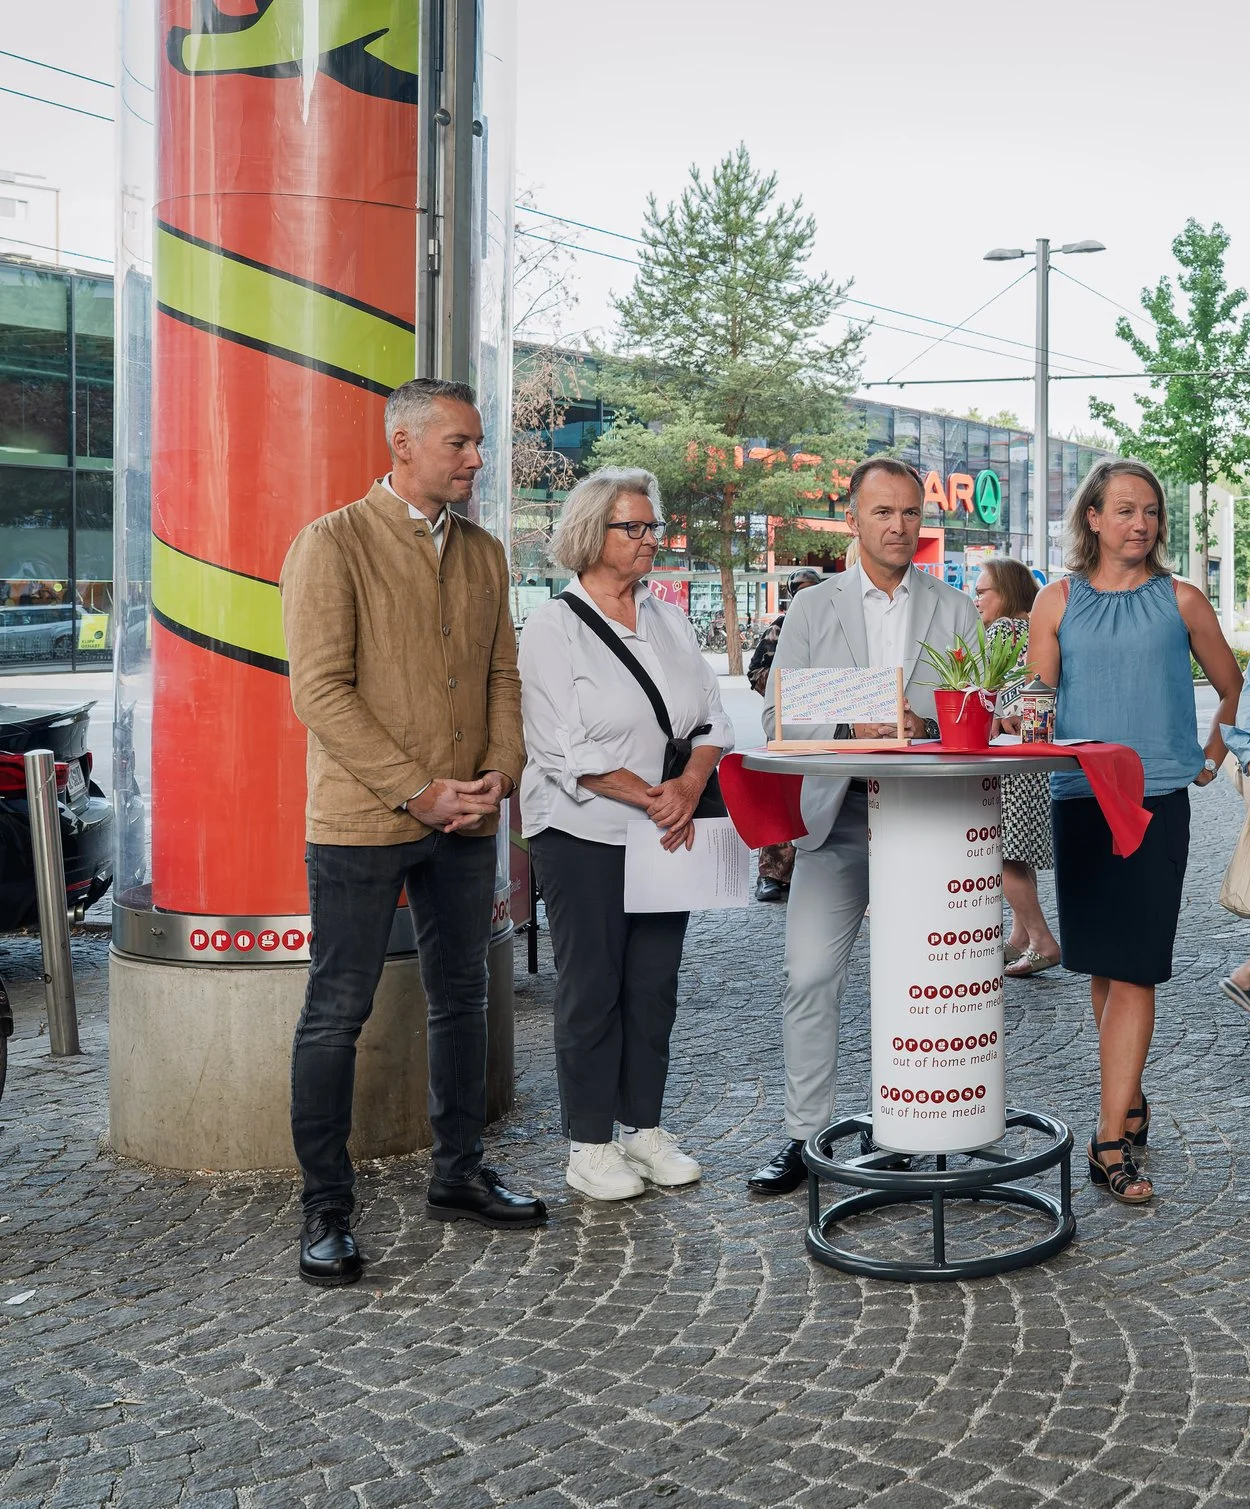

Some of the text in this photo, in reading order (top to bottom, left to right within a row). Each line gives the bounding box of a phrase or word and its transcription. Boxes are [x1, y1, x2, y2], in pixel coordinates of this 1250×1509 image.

[966, 847, 984, 857] out
[948, 899, 968, 909] out
[971, 896, 983, 908] of
[190, 928, 311, 953] progr
[928, 952, 949, 961] out
[953, 948, 967, 961] of
[970, 945, 995, 959] home
[909, 1005, 930, 1015] out
[934, 1003, 949, 1015] of
[952, 1001, 983, 1014] home
[892, 1030, 998, 1052] progress
[893, 1049, 998, 1068] out of home media
[880, 1084, 987, 1104] progress
[880, 1104, 986, 1119] out of home media
